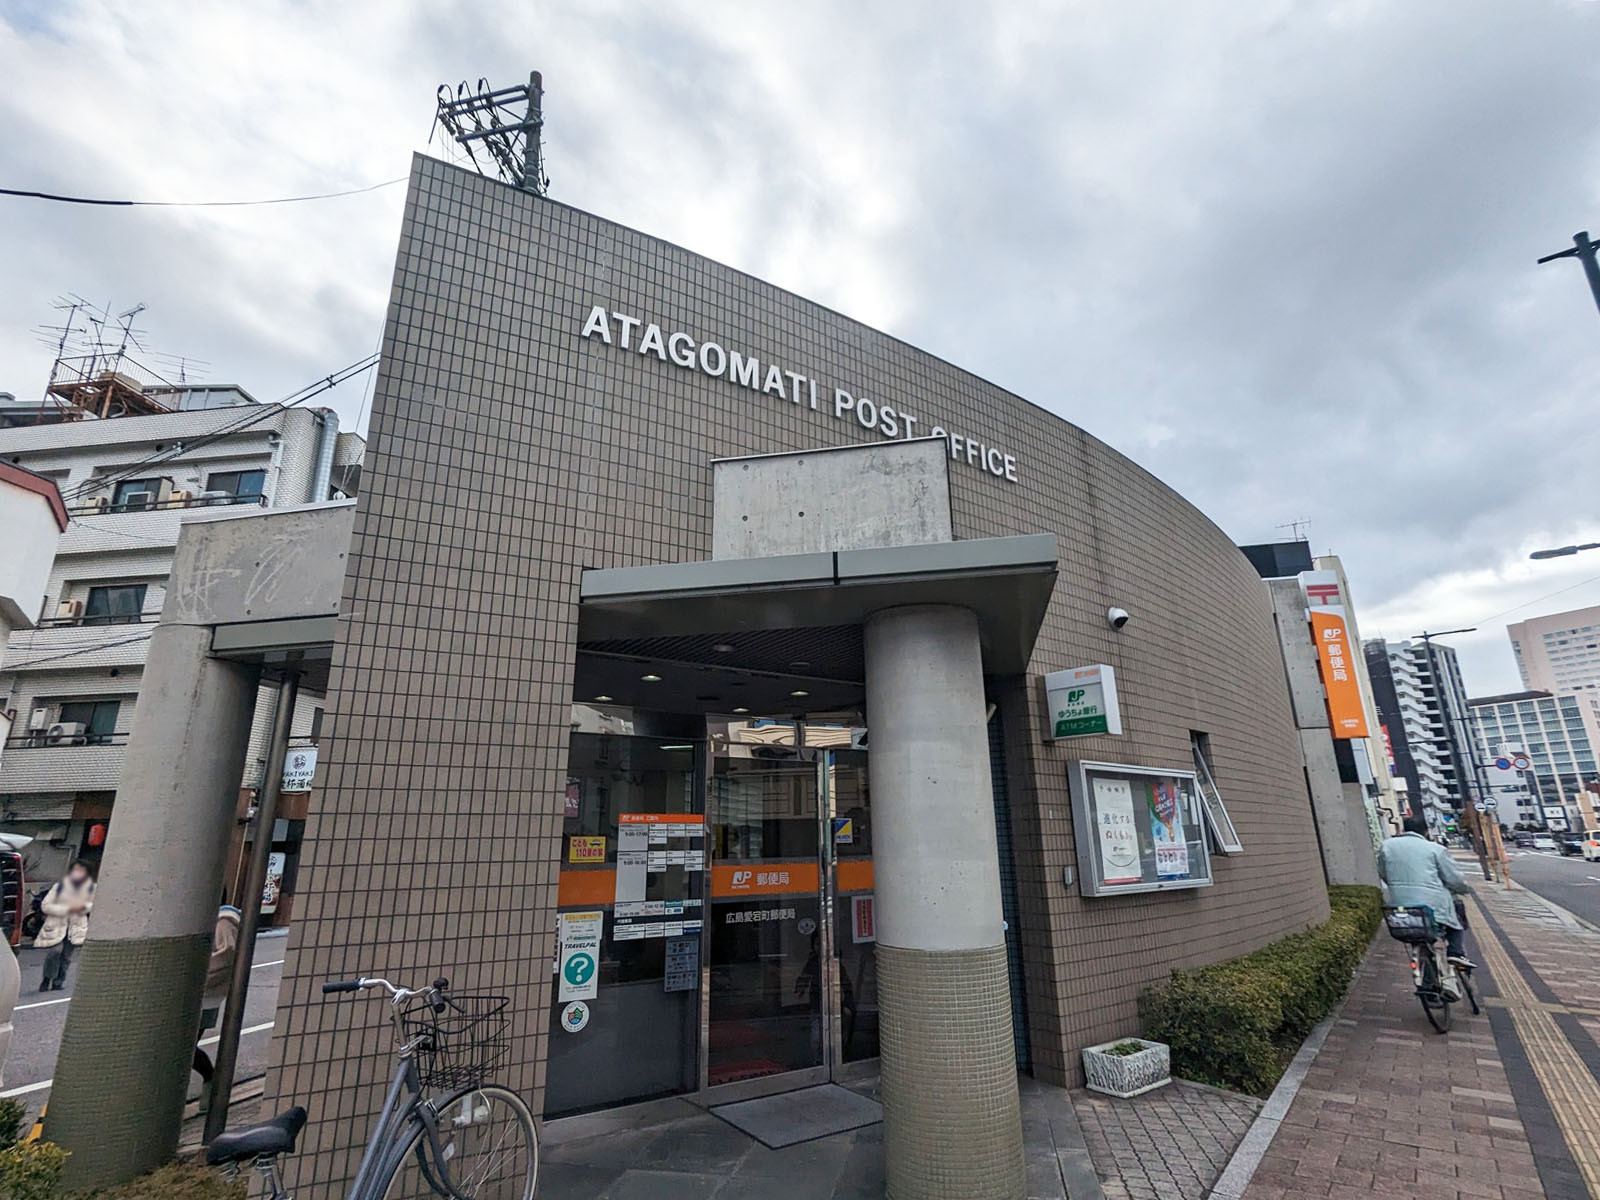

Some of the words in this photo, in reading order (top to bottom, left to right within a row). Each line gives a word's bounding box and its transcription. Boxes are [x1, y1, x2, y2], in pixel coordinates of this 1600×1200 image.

[581, 306, 818, 410] ATAGOMATI
[834, 388, 917, 440] POST
[1328, 643, 1348, 682] 郵便局
[1058, 705, 1098, 718] ゆうちょ銀行
[1060, 720, 1103, 731] ATMコーナー
[756, 871, 790, 886] 郵便局
